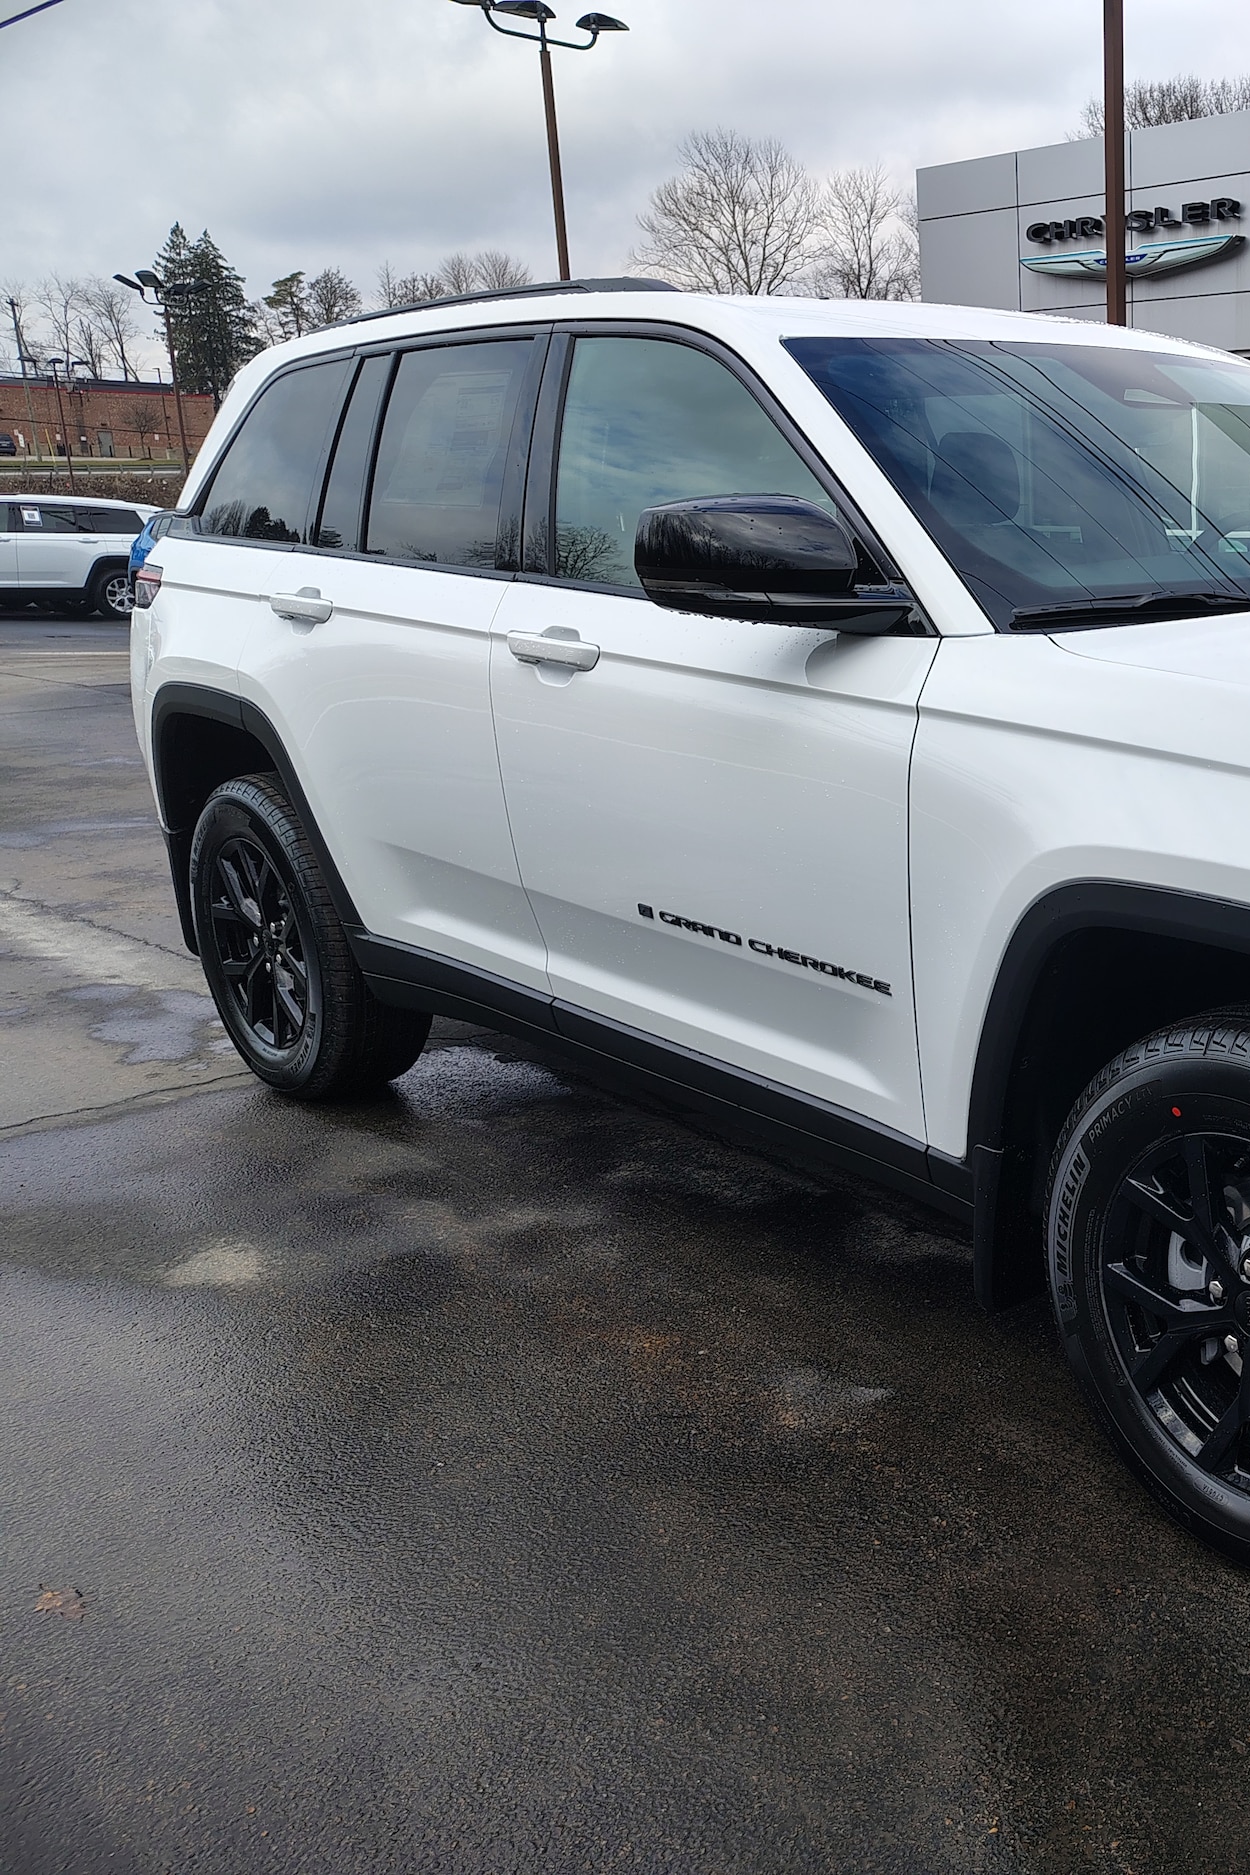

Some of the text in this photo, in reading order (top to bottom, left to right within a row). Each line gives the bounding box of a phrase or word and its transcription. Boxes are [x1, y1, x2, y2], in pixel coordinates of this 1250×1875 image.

[659, 910, 893, 997] GRAND CHEROKEE
[1088, 1095, 1133, 1144] PRIMACY
[1055, 1152, 1086, 1277] MICHELIN
